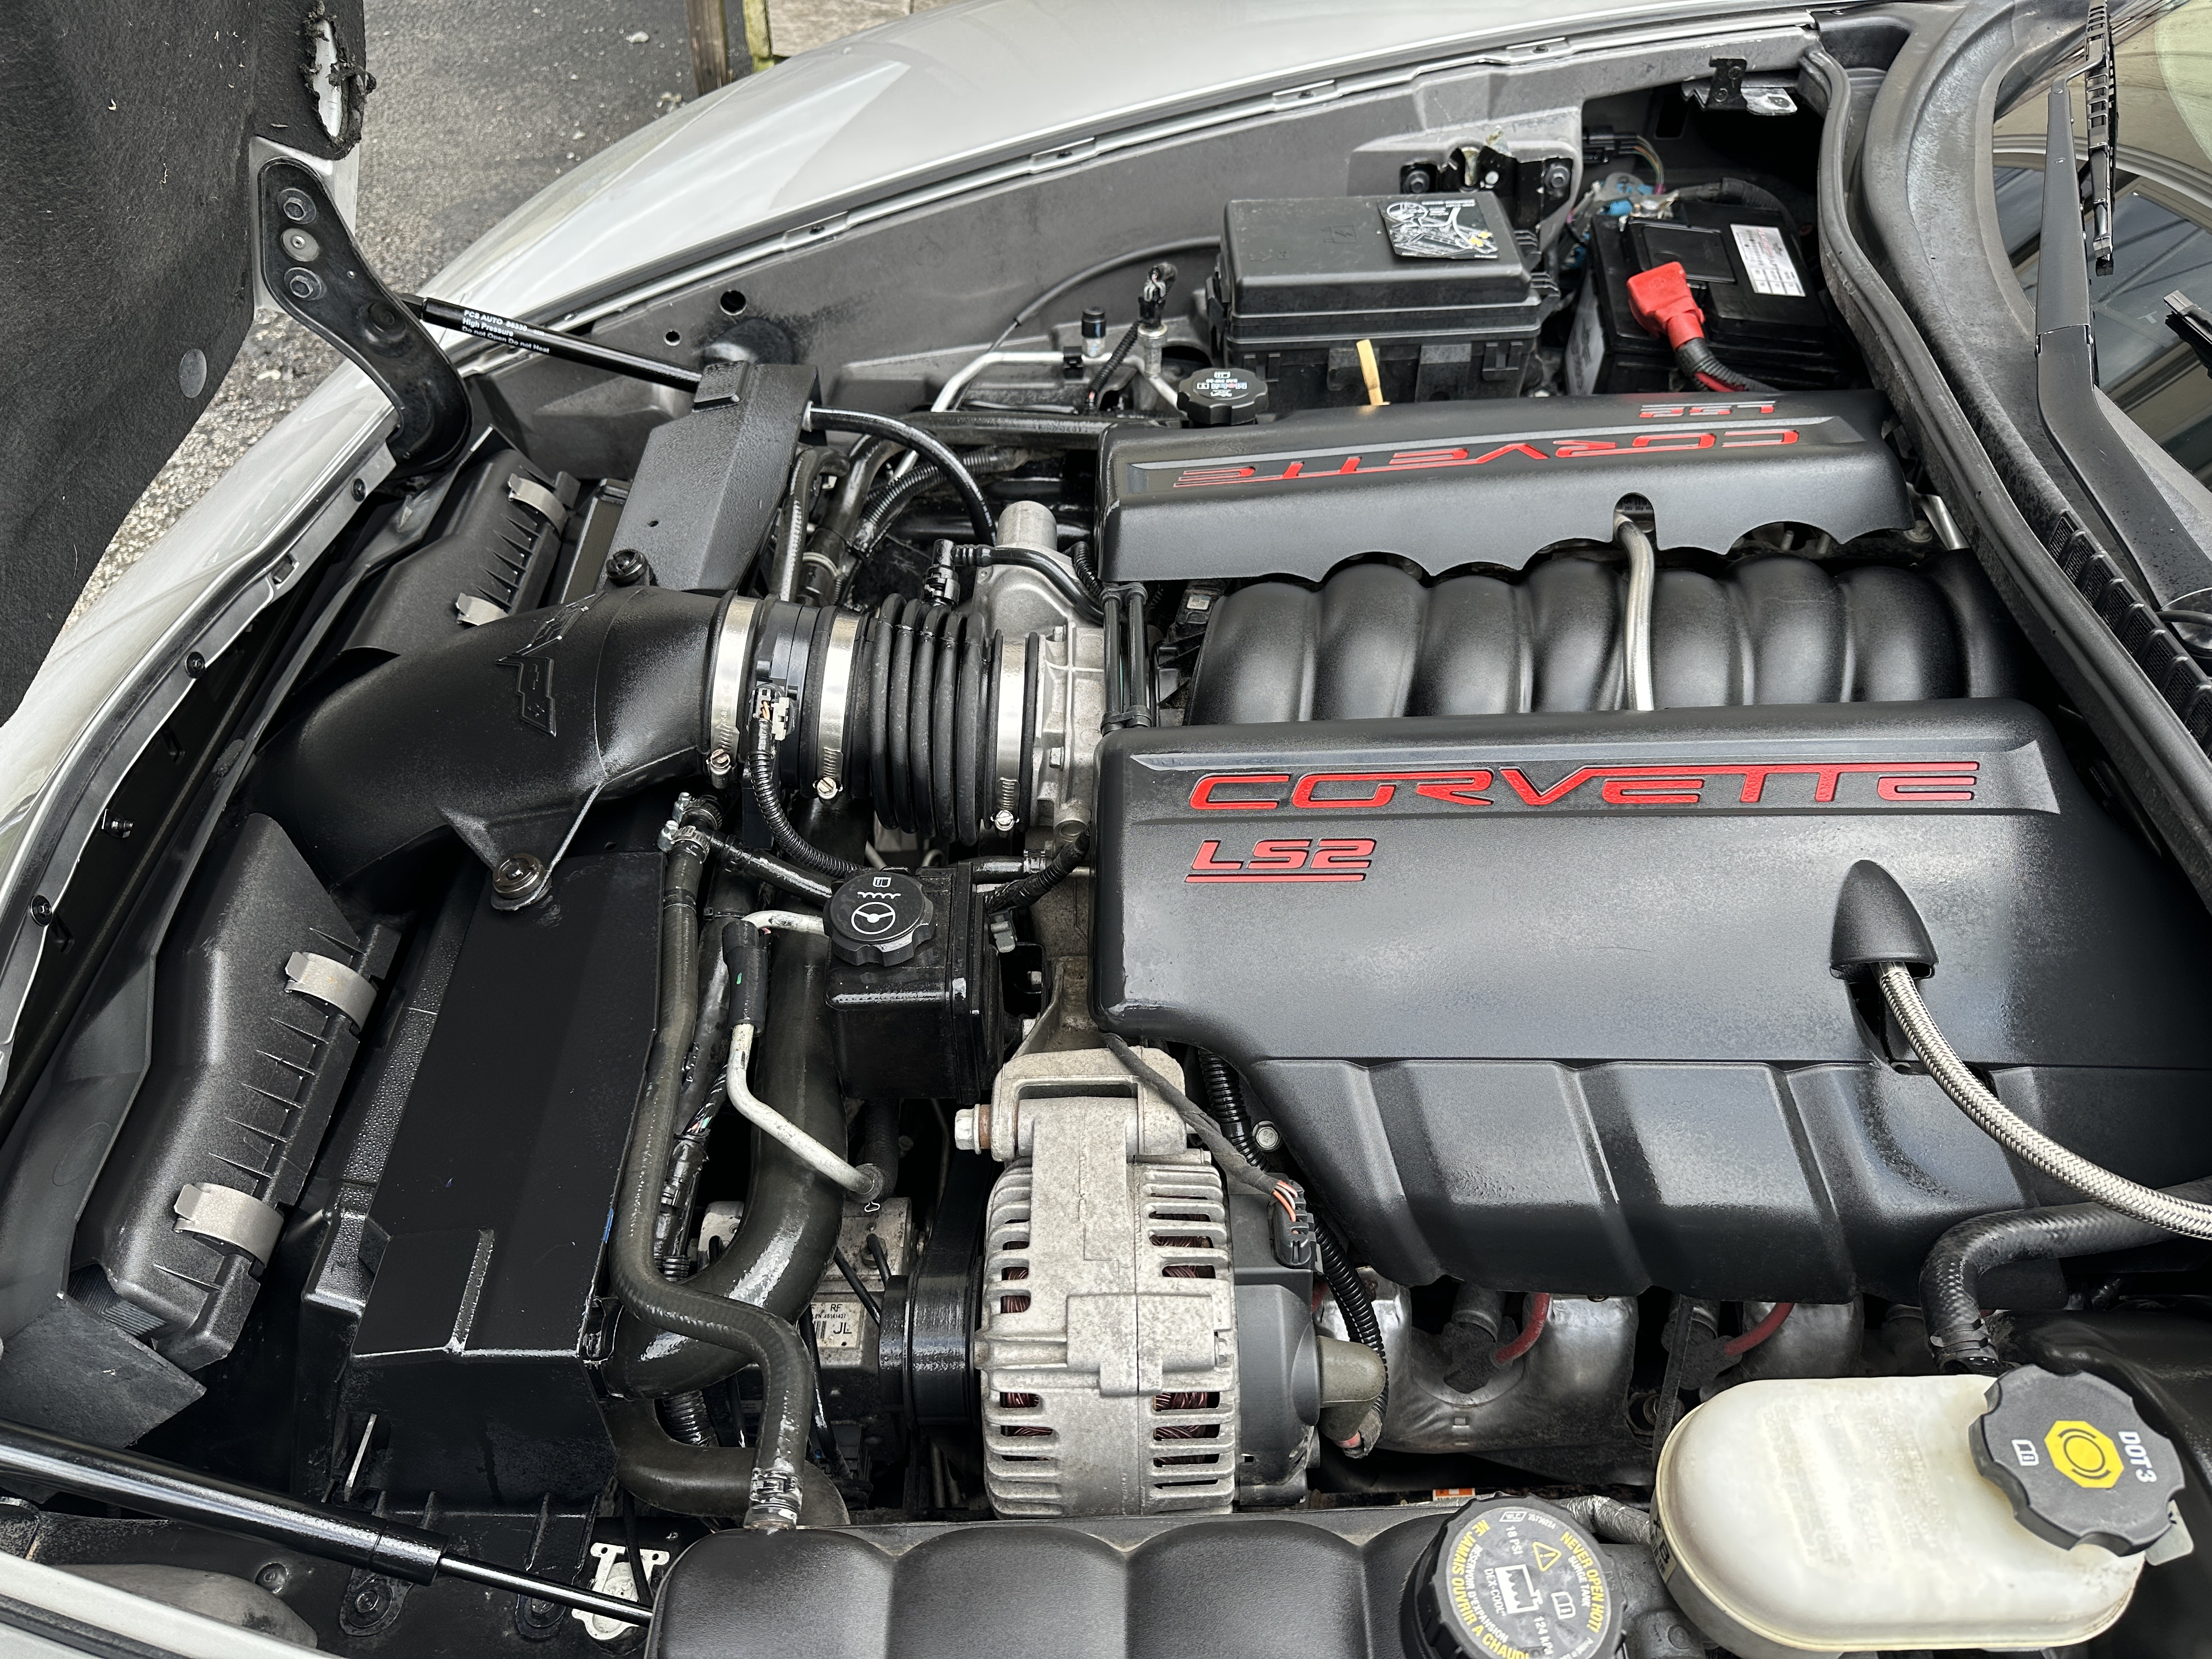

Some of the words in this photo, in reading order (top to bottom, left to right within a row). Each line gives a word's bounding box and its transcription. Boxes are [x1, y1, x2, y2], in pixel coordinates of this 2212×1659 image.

[462, 318, 480, 328] High
[481, 322, 514, 337] Pressure
[464, 309, 480, 319] FCS
[481, 314, 503, 325] AUTO
[487, 332, 507, 342] Open
[533, 343, 550, 354] Heat
[1639, 404, 1775, 418] LS2
[1173, 430, 1799, 488] CORVETTE
[1188, 761, 1978, 811] CORVETTE
[1192, 839, 1375, 870] LS2
[831, 1304, 843, 1312] RF
[833, 1322, 852, 1334] JL
[2118, 1431, 2152, 1472] DOT
[2136, 1470, 2157, 1483] 3
[1471, 1519, 1491, 1537] NE
[1505, 1526, 1517, 1537] 18
[1451, 1531, 1476, 1575] JAMAIS
[1509, 1539, 1523, 1555] PSI
[1560, 1531, 1594, 1568] NEVER
[1568, 1555, 1587, 1583] SURGE
[1580, 1584, 1592, 1608] TANK
[1586, 1569, 1604, 1602] OPEN
[1452, 1577, 1478, 1626] OUVRIR
[1534, 1616, 1549, 1635] 124
[1587, 1603, 1604, 1633] HOT!
[1471, 1624, 1485, 1637] A
